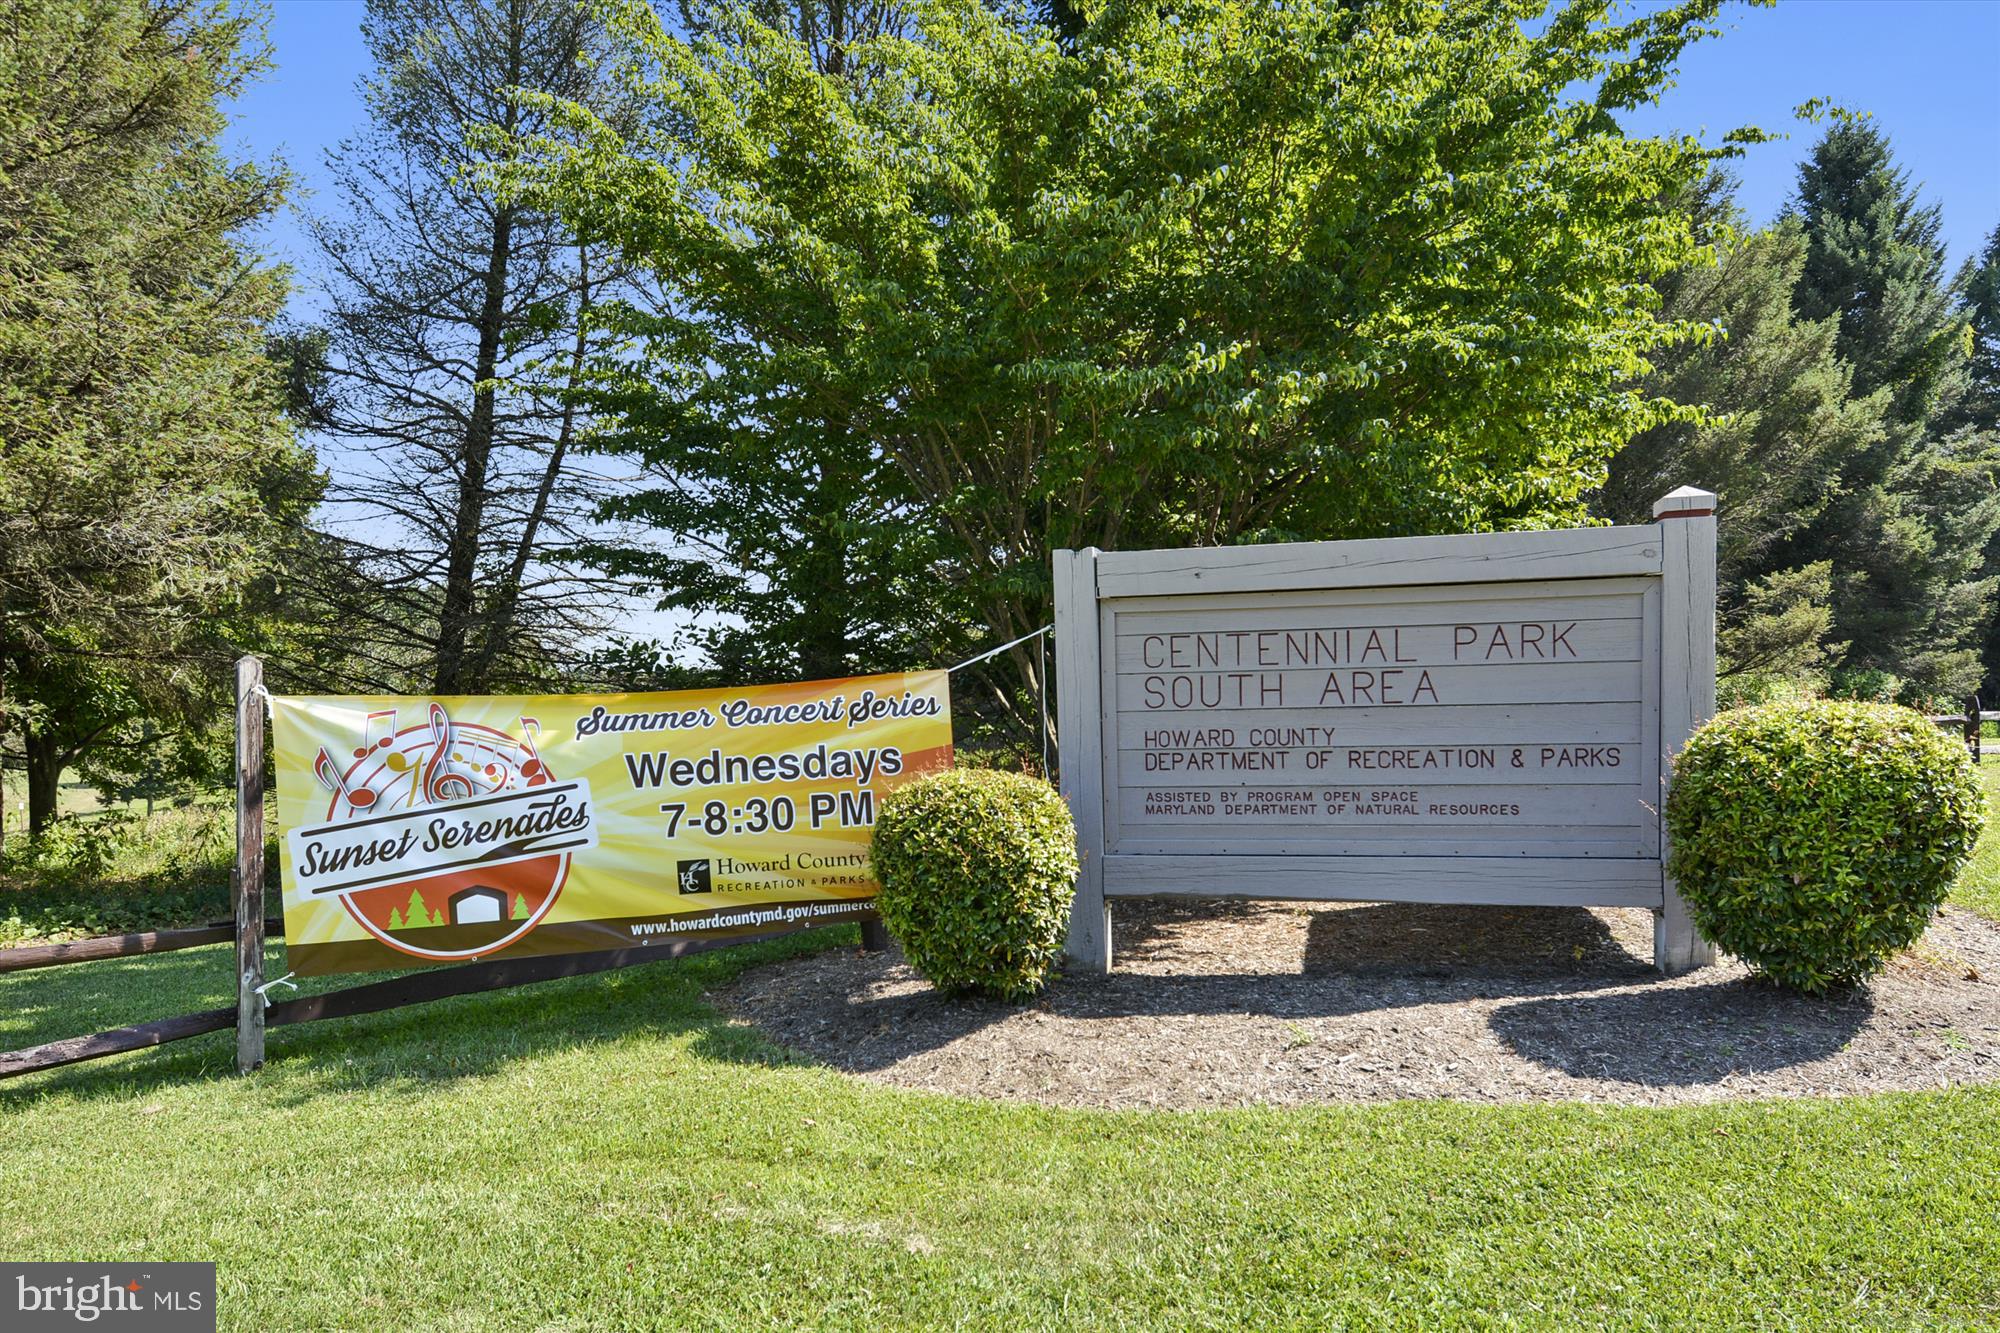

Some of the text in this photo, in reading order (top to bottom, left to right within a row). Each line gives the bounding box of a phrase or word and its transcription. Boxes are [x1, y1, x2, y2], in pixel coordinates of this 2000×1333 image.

[1143, 622, 1578, 667] CENTENNIAL PARK
[1144, 669, 1440, 709] SOUTH AREA
[577, 690, 941, 740] Summer Concert Series
[1144, 727, 1336, 748] HOWARD COUNTY
[624, 744, 902, 789] Wednesdays
[1144, 748, 1620, 772] DEPARTMENT OF RECREATION & PARKS
[1145, 804, 1520, 816] MARYLAND DEPARTMENT OF NATURAL RESOURCES
[1146, 791, 1419, 803] ASSISTED BY PROGRAM OPEN SPACE
[660, 790, 874, 839] 7-8:30 PM
[299, 794, 589, 878] Sunset Serenades
[715, 852, 866, 875] Howard County
[717, 879, 805, 892] RECREATION
[821, 874, 866, 886] PARKS
[631, 902, 877, 935] www.howardcountymd.gov/summerco
